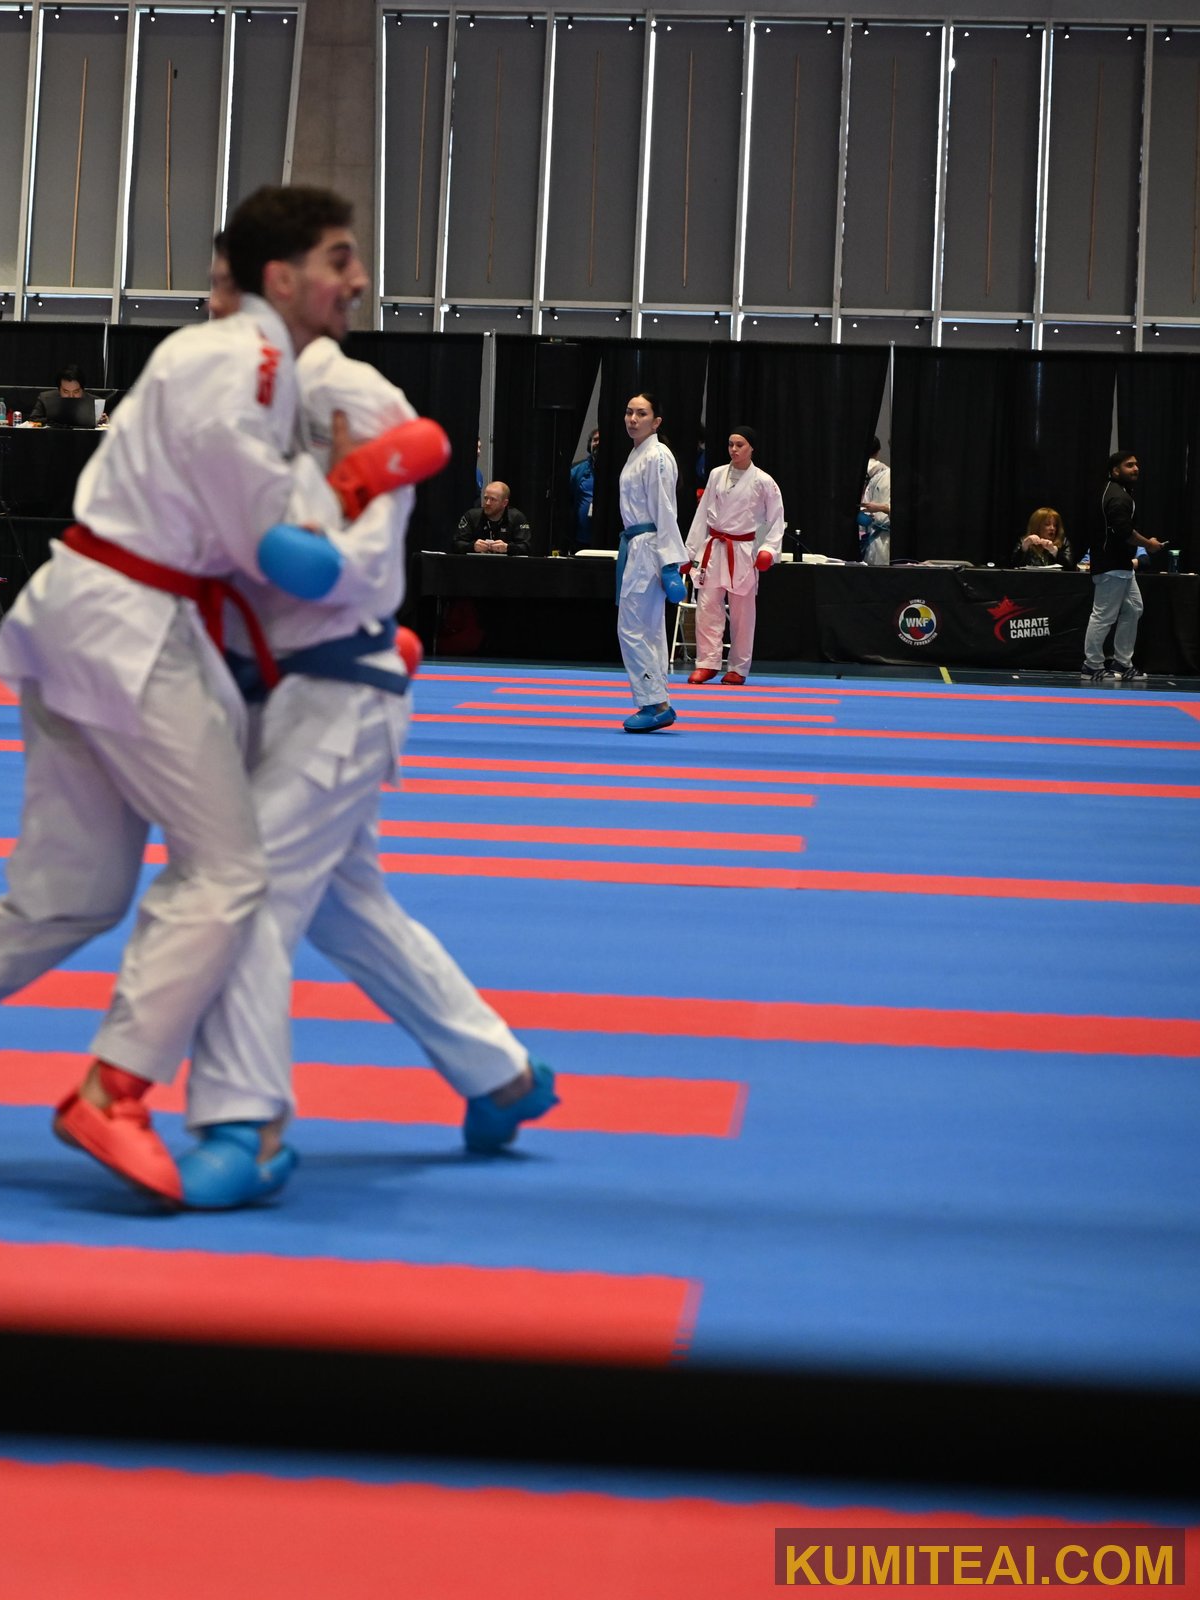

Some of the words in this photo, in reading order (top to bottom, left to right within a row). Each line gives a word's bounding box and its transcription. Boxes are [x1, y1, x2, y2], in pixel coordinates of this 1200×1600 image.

[905, 617, 929, 628] WKF
[1009, 617, 1050, 630] KARATE
[1010, 626, 1051, 639] CANADA
